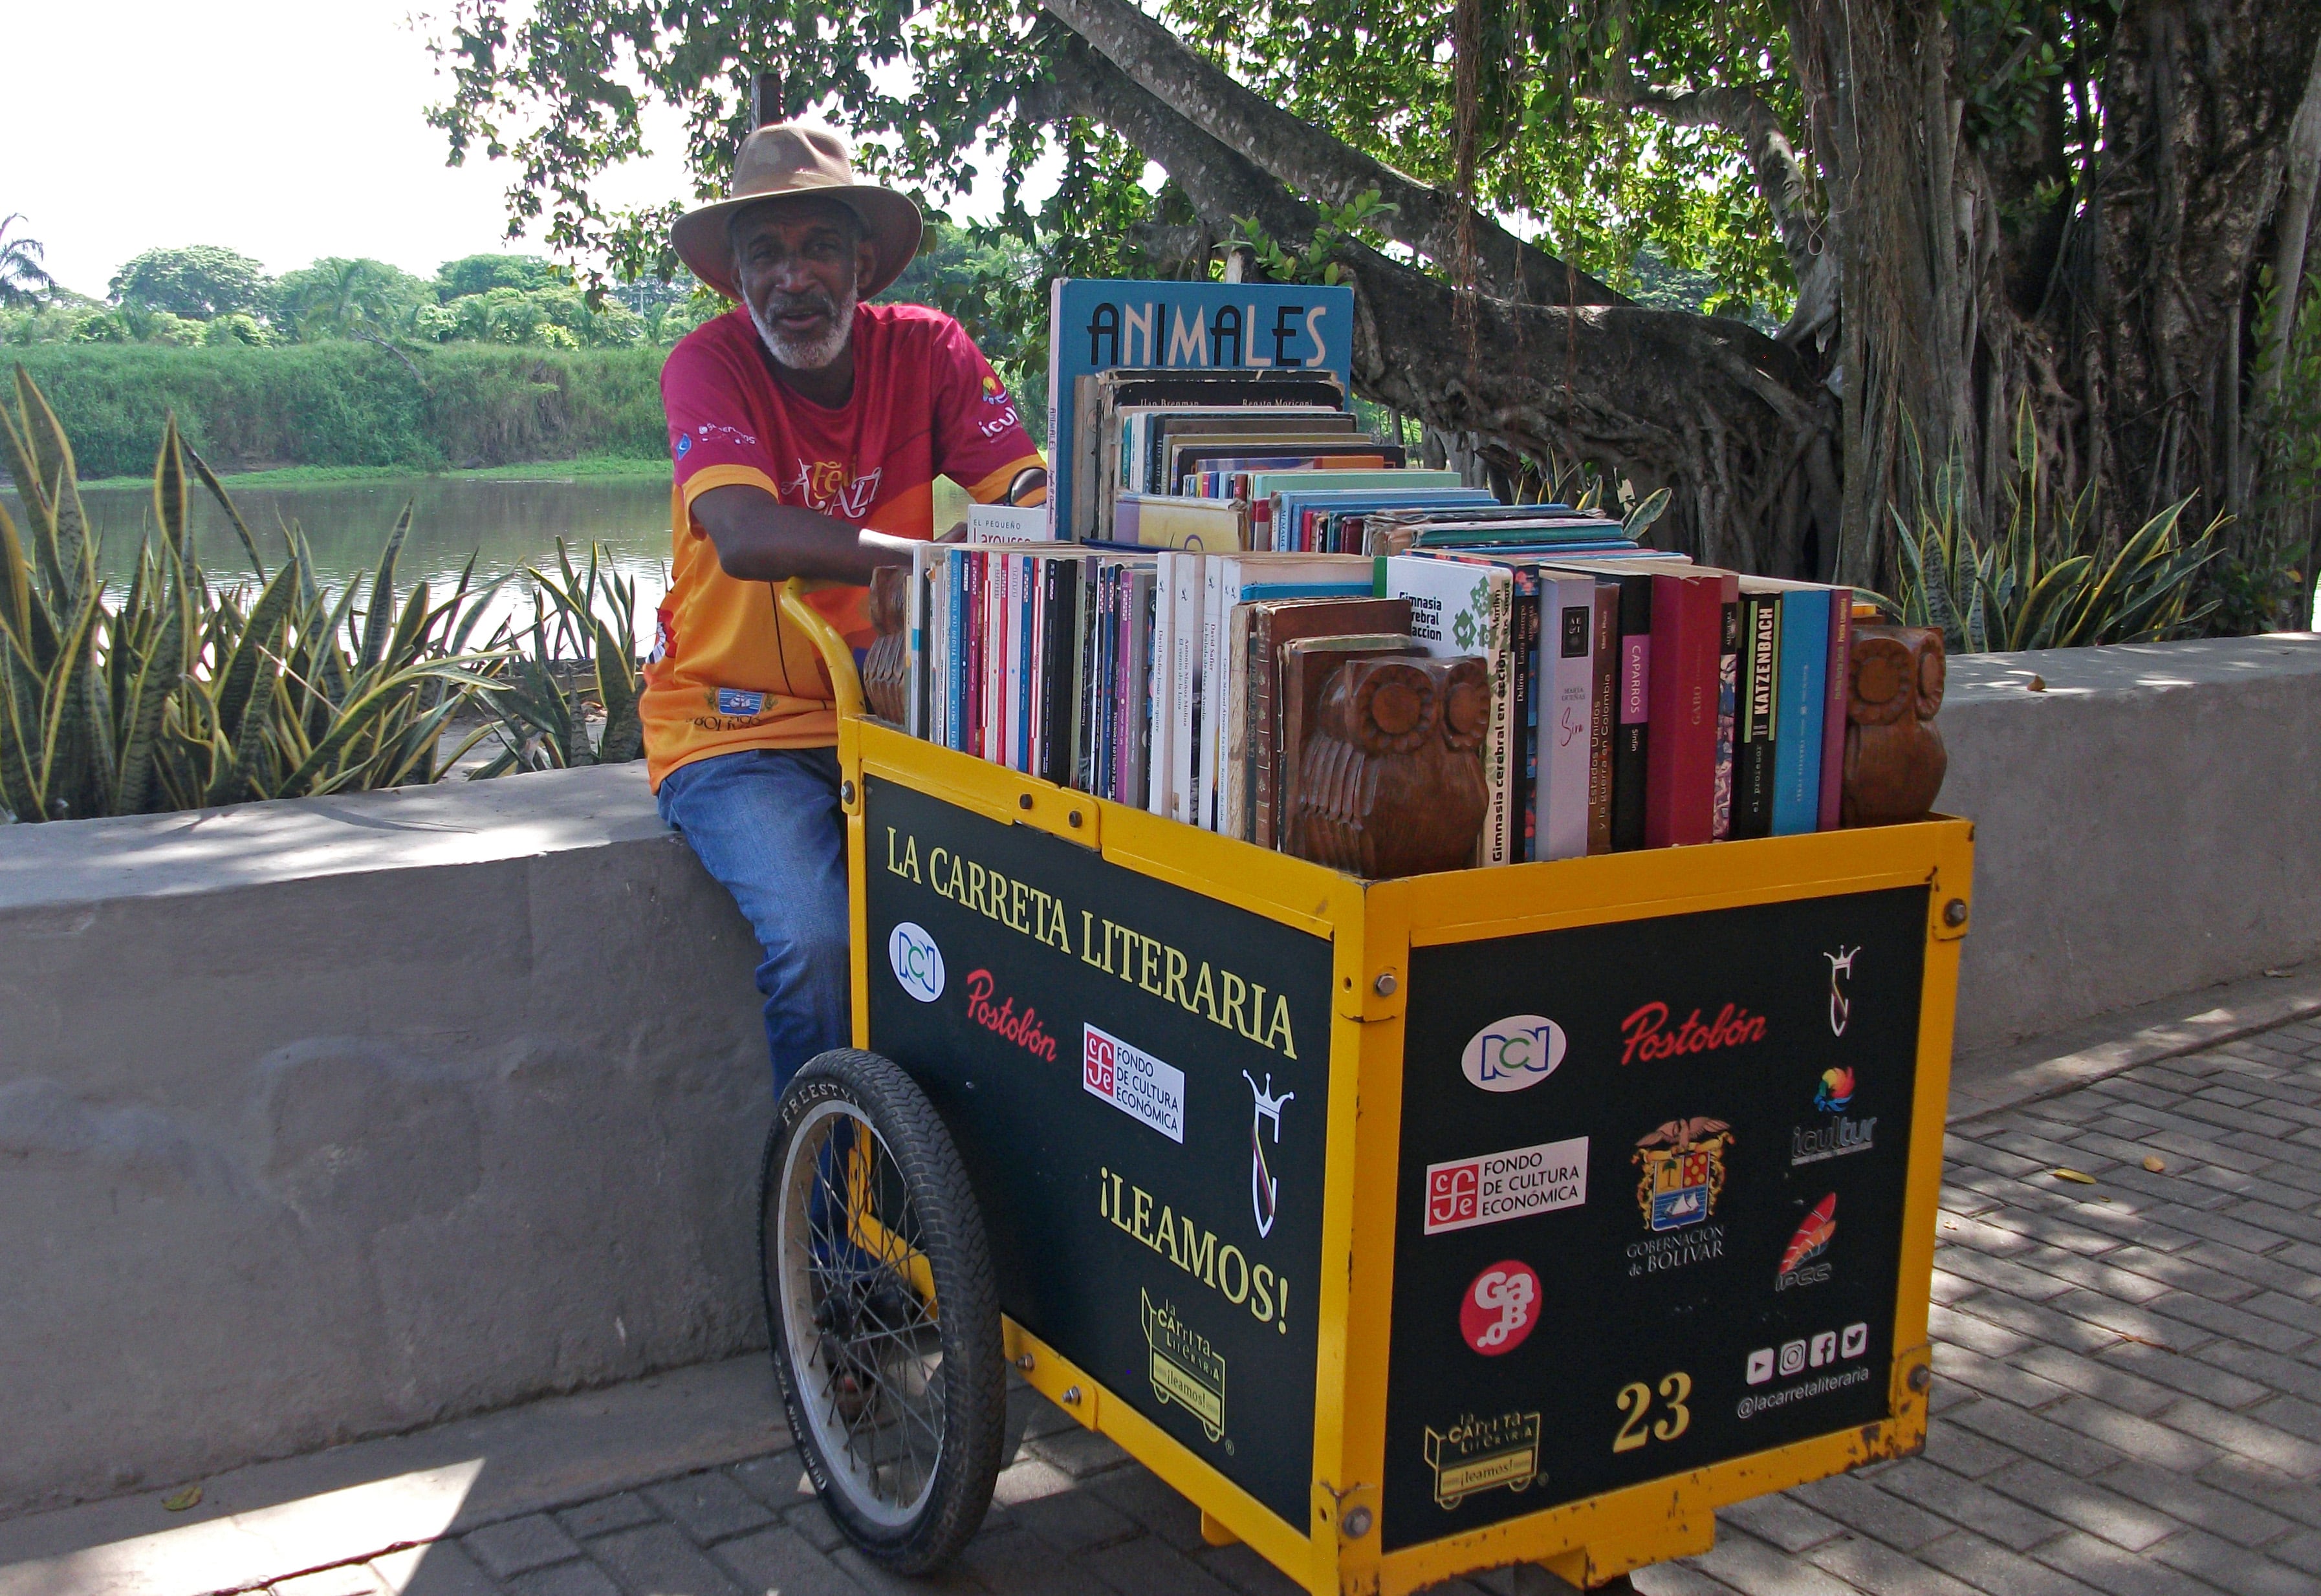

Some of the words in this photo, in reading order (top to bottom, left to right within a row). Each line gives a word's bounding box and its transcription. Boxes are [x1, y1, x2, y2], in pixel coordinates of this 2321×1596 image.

[1087, 302, 1327, 367] ANIMALES
[985, 520, 1021, 530] PEQUEÑO
[1411, 610, 1439, 626] rebral
[1492, 588, 1502, 630] Marilyn
[1518, 605, 1527, 640] Restrepo
[1630, 645, 1641, 714] CAPARRÓS
[1754, 607, 1774, 715] KATZENBACH
[1516, 673, 1524, 702] Delirio
[1602, 673, 1611, 735] Colombia
[1692, 685, 1701, 725] GABO
[1497, 706, 1506, 722] en
[1561, 707, 1584, 747] Sira
[1592, 700, 1601, 741] Unidos
[1495, 729, 1506, 788] cerebral
[1602, 741, 1608, 754] en
[1589, 742, 1598, 806] Estados
[1492, 792, 1503, 862] Gimnasia
[1600, 806, 1606, 819] la
[1752, 801, 1758, 812] el
[887, 826, 922, 884] LA
[929, 847, 1071, 954] CARRETA
[1081, 910, 1298, 1060] LITERARIA
[899, 930, 936, 995] RCN
[967, 969, 1057, 1062] Postobón
[1620, 1000, 1767, 1066] Postobón
[1117, 1046, 1154, 1078] FONDO
[1480, 1025, 1550, 1082] RCN
[782, 1083, 860, 1127] FREESTYL
[1116, 1086, 1178, 1134] ECONÓMICA
[1117, 1066, 1129, 1086] DE
[1132, 1075, 1179, 1113] CULTURA
[1792, 1115, 1878, 1158] icultur
[1483, 1179, 1503, 1196] DE
[1509, 1165, 1580, 1191] CULTURA
[1484, 1152, 1543, 1177] FONDO
[1482, 1185, 1578, 1216] ECONÓMICA
[1101, 1166, 1289, 1335] ¡LEAMOS!
[1628, 1263, 1642, 1277] de
[1166, 1370, 1207, 1409] ¡leamos!
[1738, 1366, 1869, 1419] @lacarretaliteraria
[1612, 1371, 1693, 1454] 23
